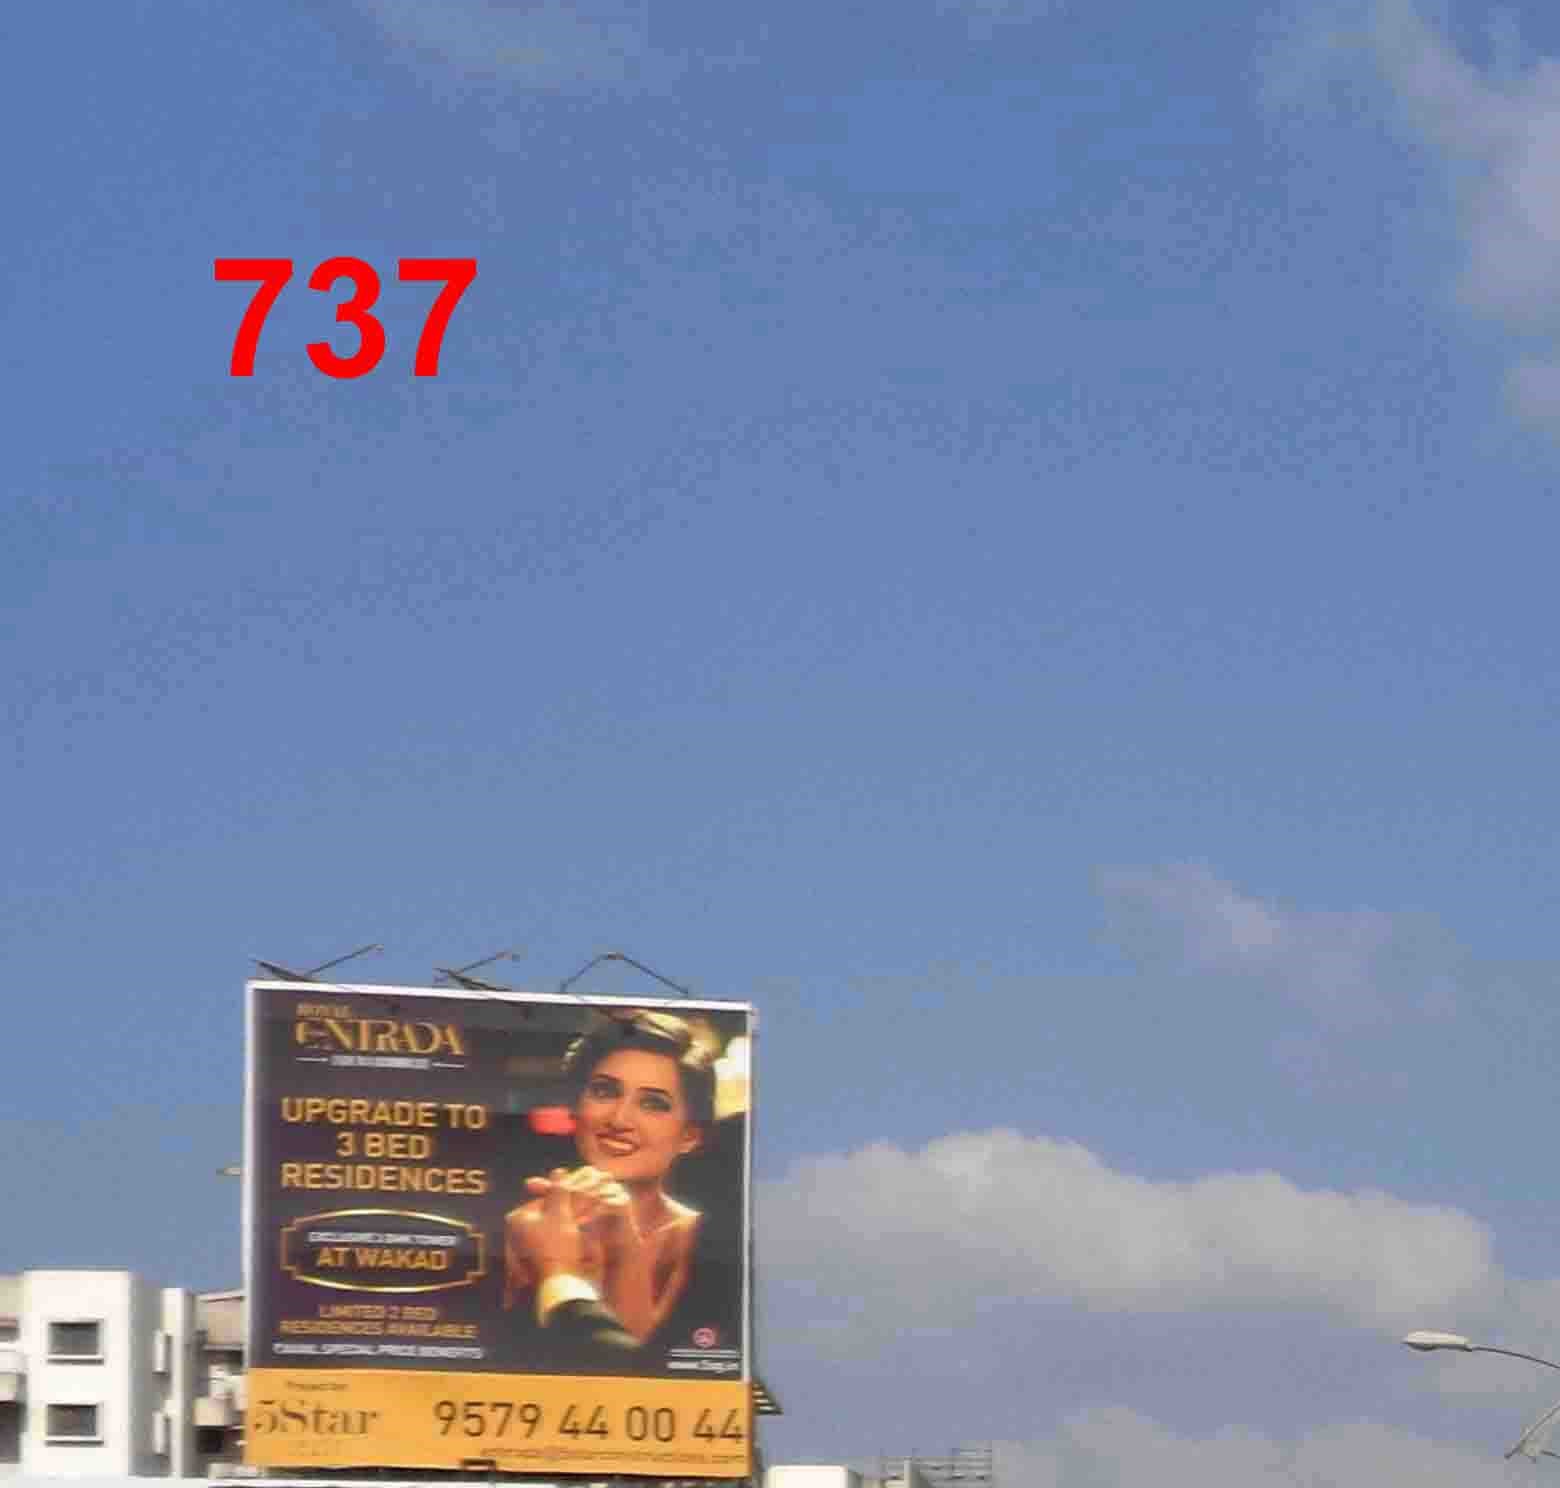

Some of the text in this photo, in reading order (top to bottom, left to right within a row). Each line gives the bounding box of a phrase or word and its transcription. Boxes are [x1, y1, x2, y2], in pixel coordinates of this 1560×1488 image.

[281, 1097, 488, 1129] UPGRADE TO
[335, 1131, 432, 1160] 3 BED
[281, 1162, 488, 1195] RESIDENCES
[317, 1247, 448, 1271] AT WAKAD
[253, 1399, 380, 1436] 5Star
[434, 1400, 744, 1443] 9579 44 00 44
